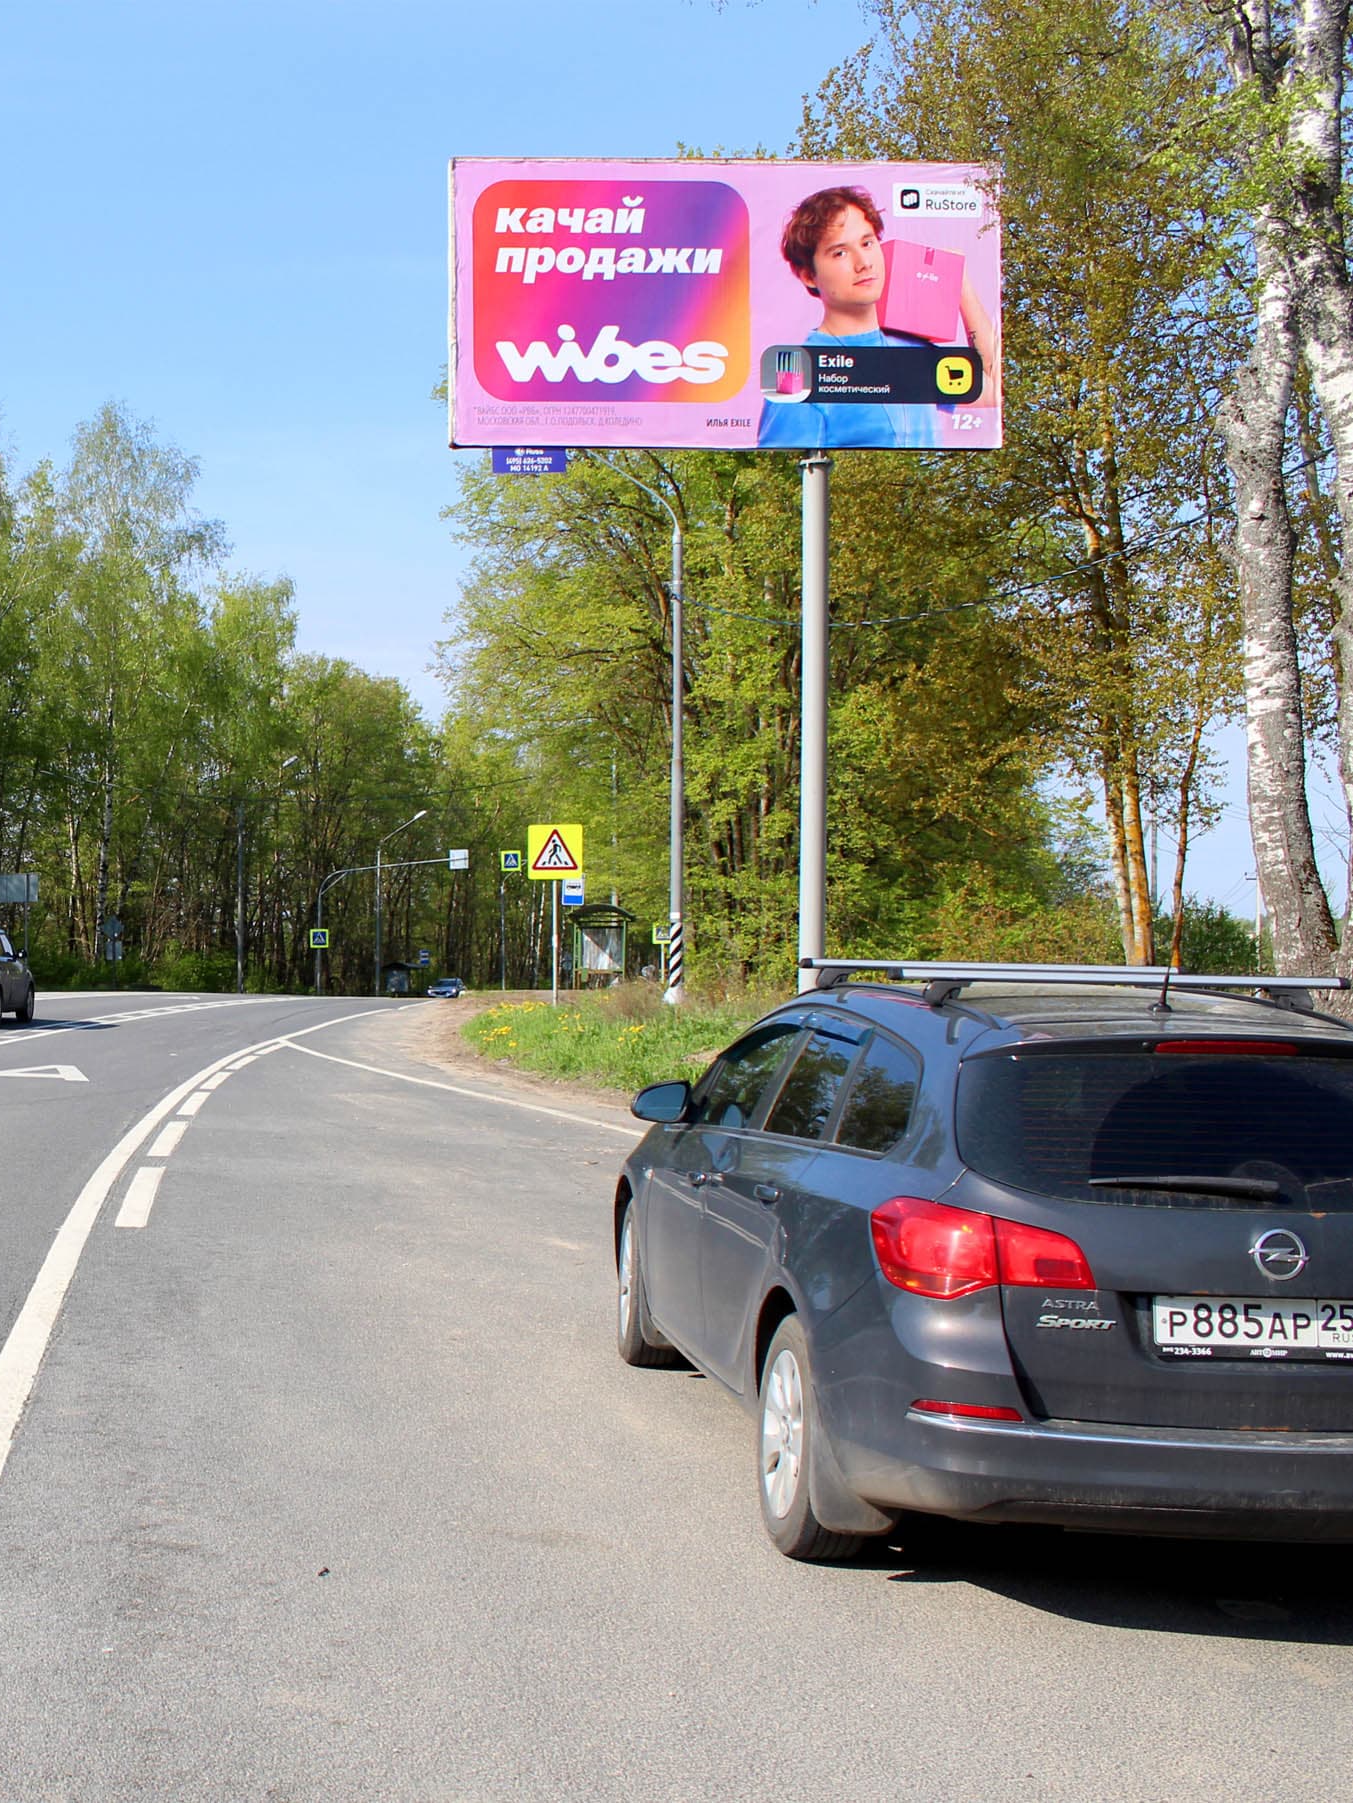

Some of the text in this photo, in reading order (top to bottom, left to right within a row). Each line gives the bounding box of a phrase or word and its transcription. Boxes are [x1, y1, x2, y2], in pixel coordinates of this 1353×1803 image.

[925, 199, 977, 211] RuStore
[495, 195, 646, 234] качай
[495, 247, 723, 284] продажи
[818, 355, 854, 368] Exile
[818, 373, 849, 384] Набор
[818, 384, 891, 393] косметический
[706, 418, 752, 428] ИЛЬЯ EXILE
[951, 414, 983, 430] 12+
[1041, 1298, 1099, 1310] ASTRA
[1168, 1303, 1312, 1340] Р885АР
[1332, 1333, 1353, 1343] RU
[1174, 1347, 1213, 1355] 234-3366
